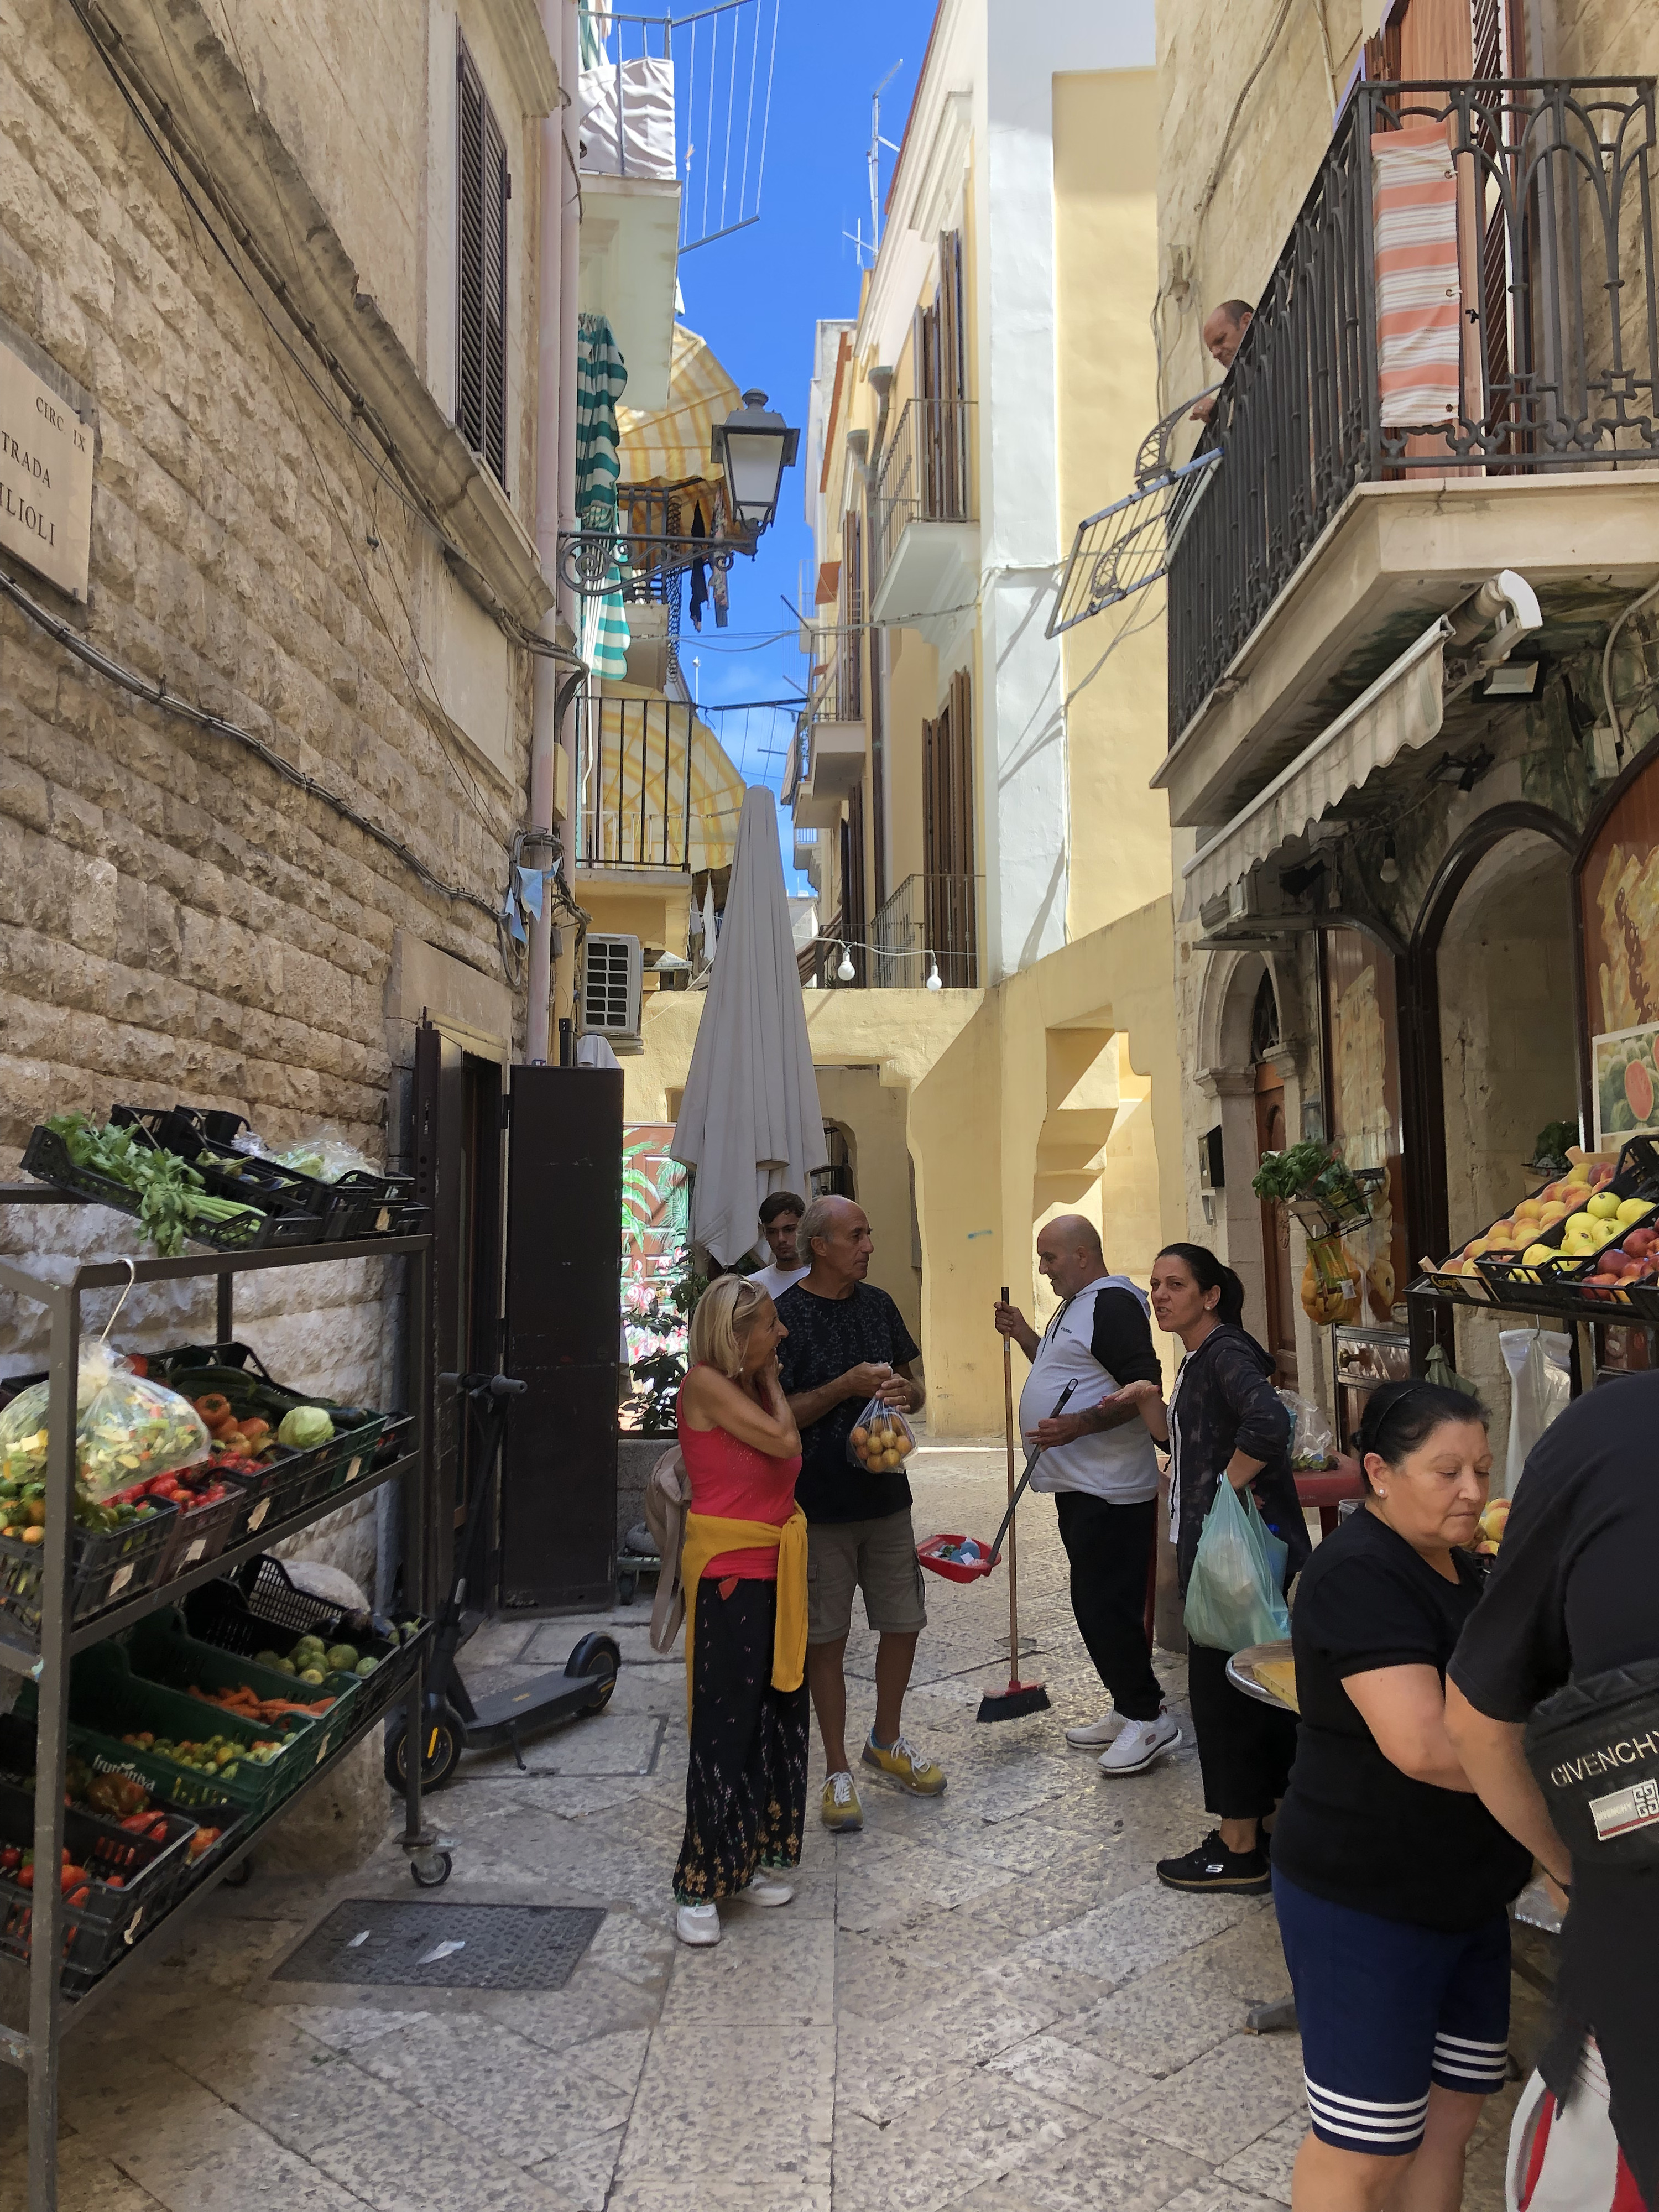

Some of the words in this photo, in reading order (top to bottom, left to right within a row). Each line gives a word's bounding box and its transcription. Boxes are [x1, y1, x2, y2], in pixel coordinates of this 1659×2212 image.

[2, 430, 51, 489] TRADA
[74, 429, 86, 453] IX
[1551, 1730, 1659, 1787] GIVENCH
